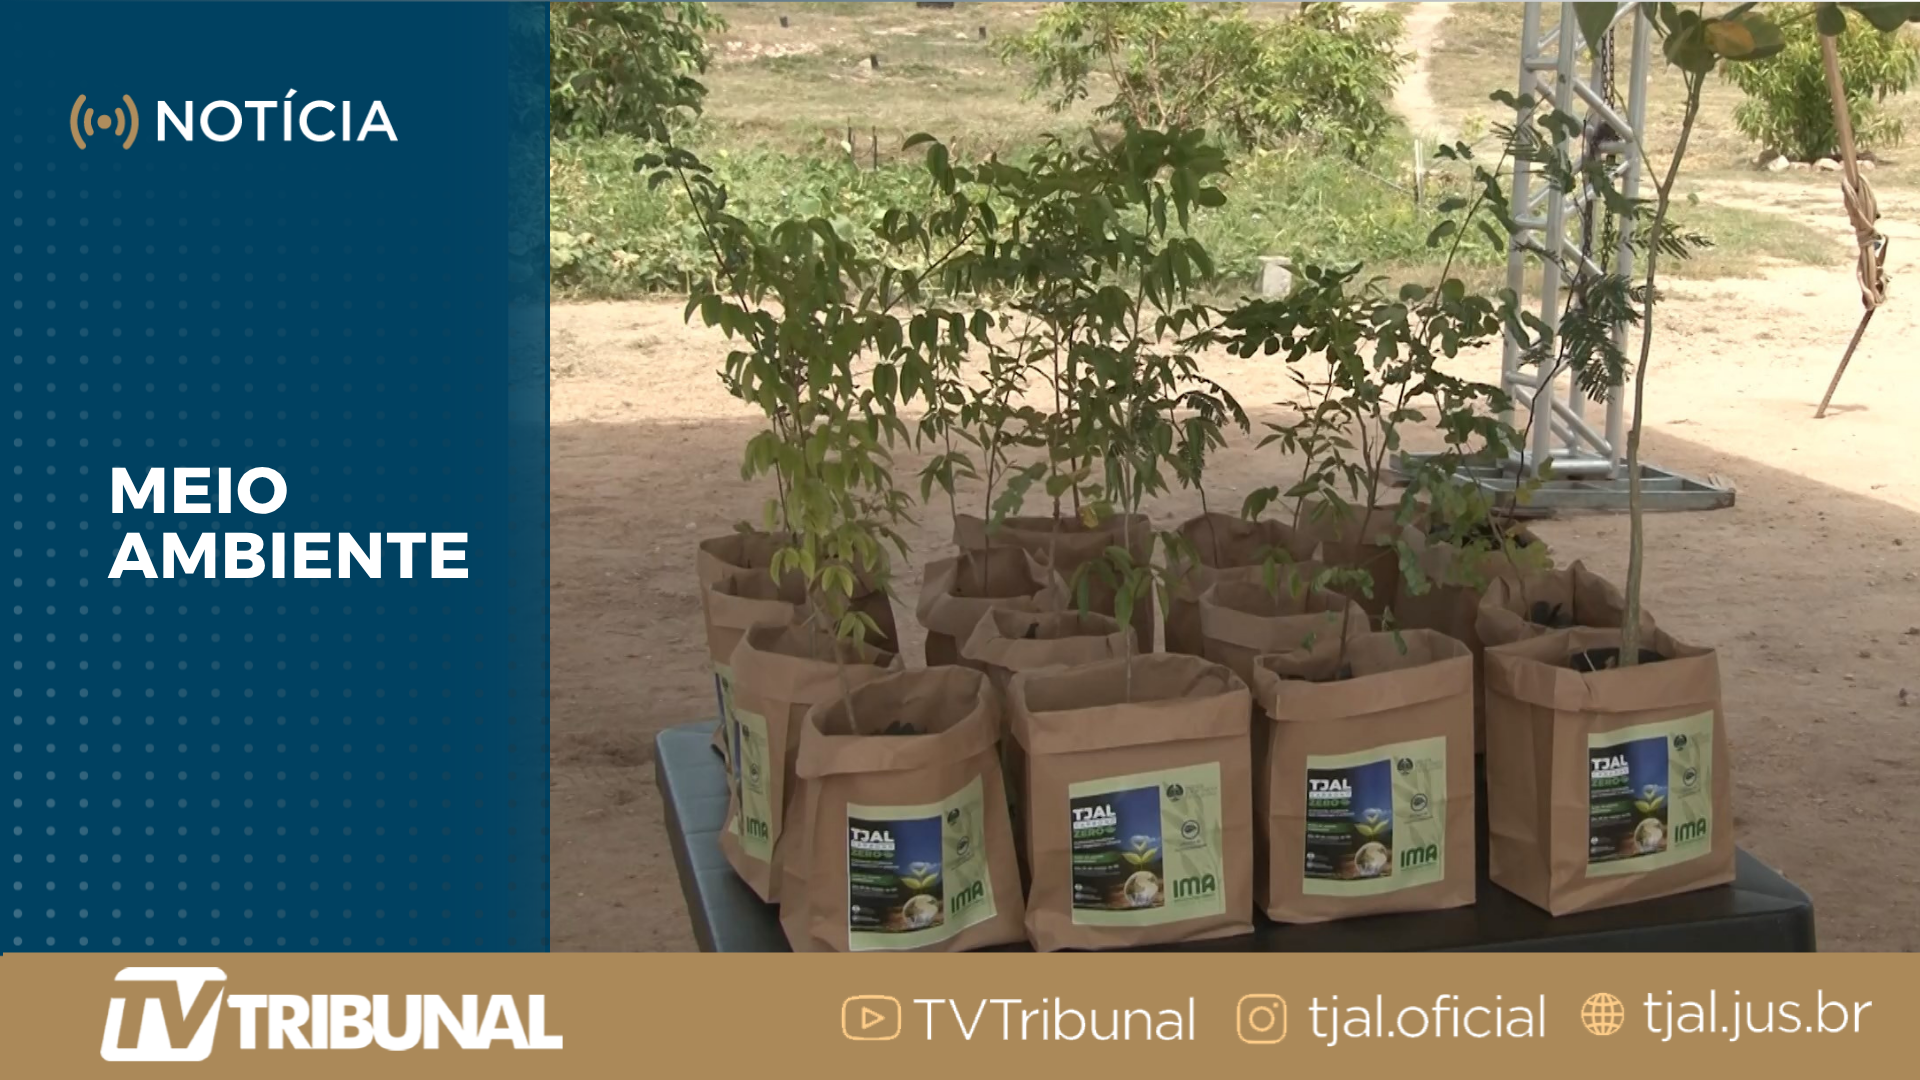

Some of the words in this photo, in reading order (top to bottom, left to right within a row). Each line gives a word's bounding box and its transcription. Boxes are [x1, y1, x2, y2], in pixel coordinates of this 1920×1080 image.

[1591, 754, 1629, 770] TJAL
[1309, 778, 1352, 791] TJAL
[1072, 803, 1116, 821] TJAL
[746, 816, 769, 840] IMA
[850, 826, 895, 842] TJAL
[1675, 817, 1707, 843] IMA
[1400, 844, 1438, 868] IMA
[950, 880, 984, 914] IMA
[1173, 873, 1216, 898] IMA
